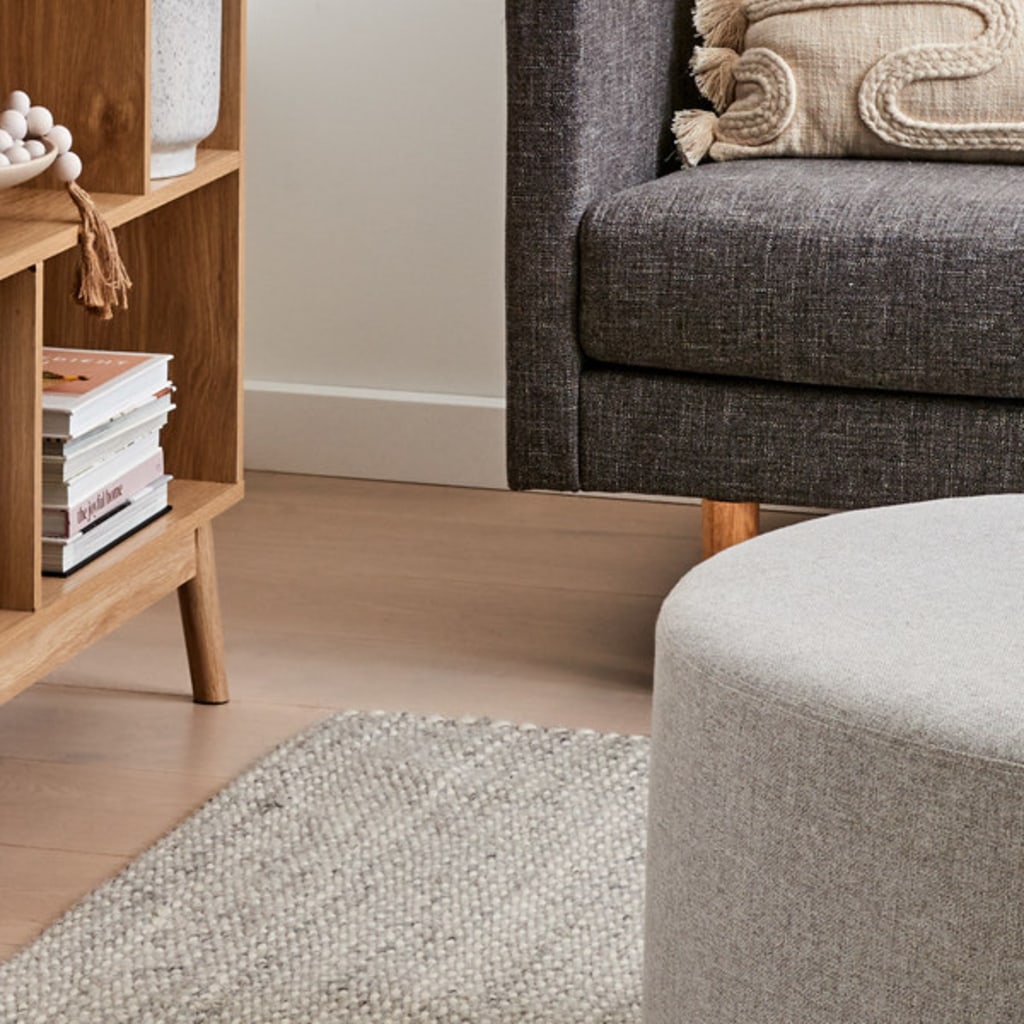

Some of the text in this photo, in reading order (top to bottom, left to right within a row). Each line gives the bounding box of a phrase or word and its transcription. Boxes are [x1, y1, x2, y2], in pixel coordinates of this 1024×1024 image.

[77, 484, 123, 524] the joyful home
